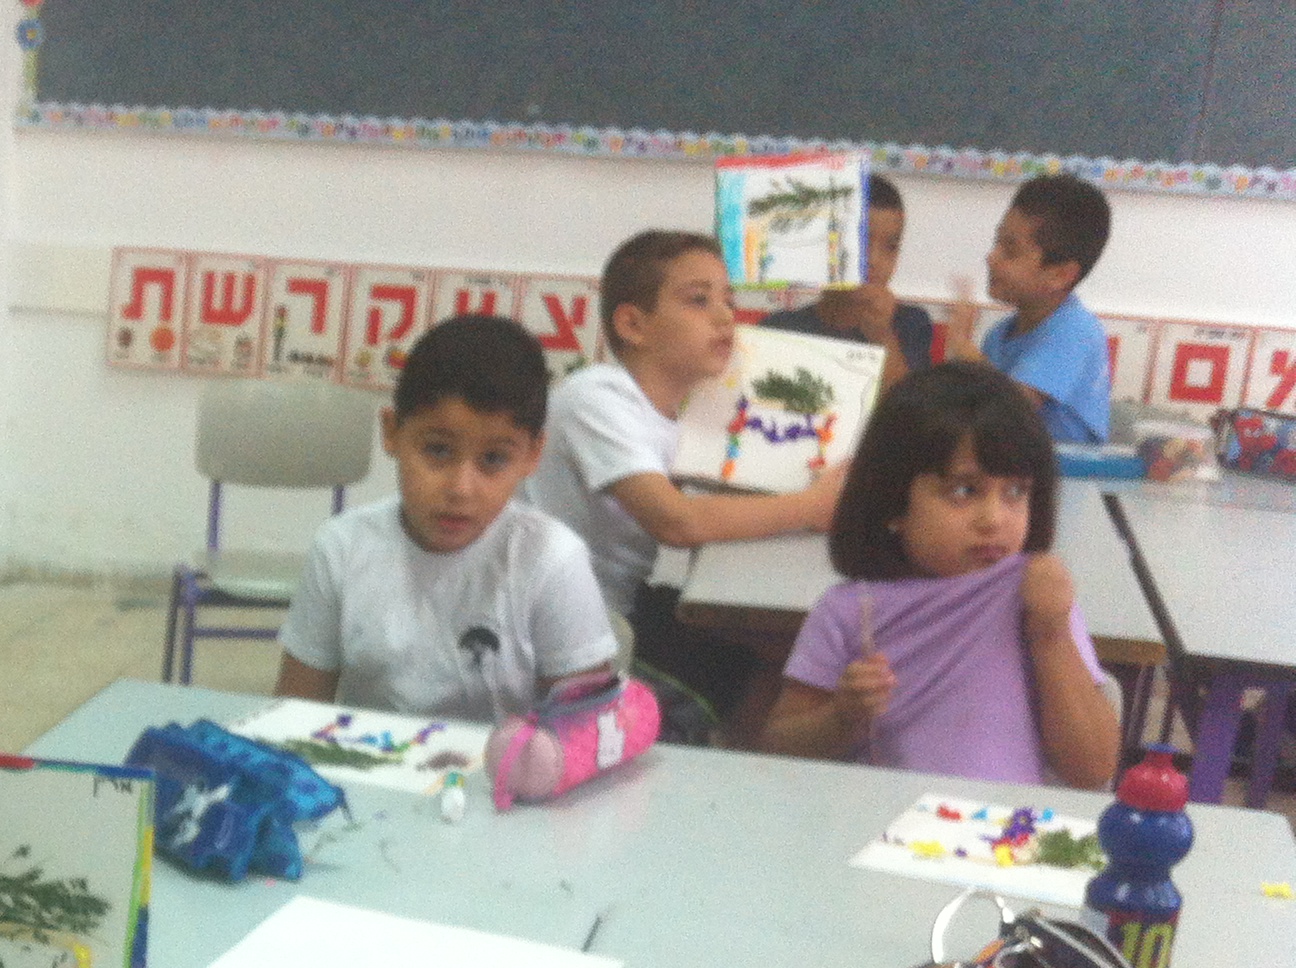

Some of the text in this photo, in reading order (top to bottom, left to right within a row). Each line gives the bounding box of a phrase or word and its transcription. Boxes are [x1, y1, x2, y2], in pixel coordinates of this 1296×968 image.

[121, 267, 177, 321] ת
[200, 271, 257, 326] ש
[287, 278, 329, 333] ר
[367, 284, 418, 346] ק
